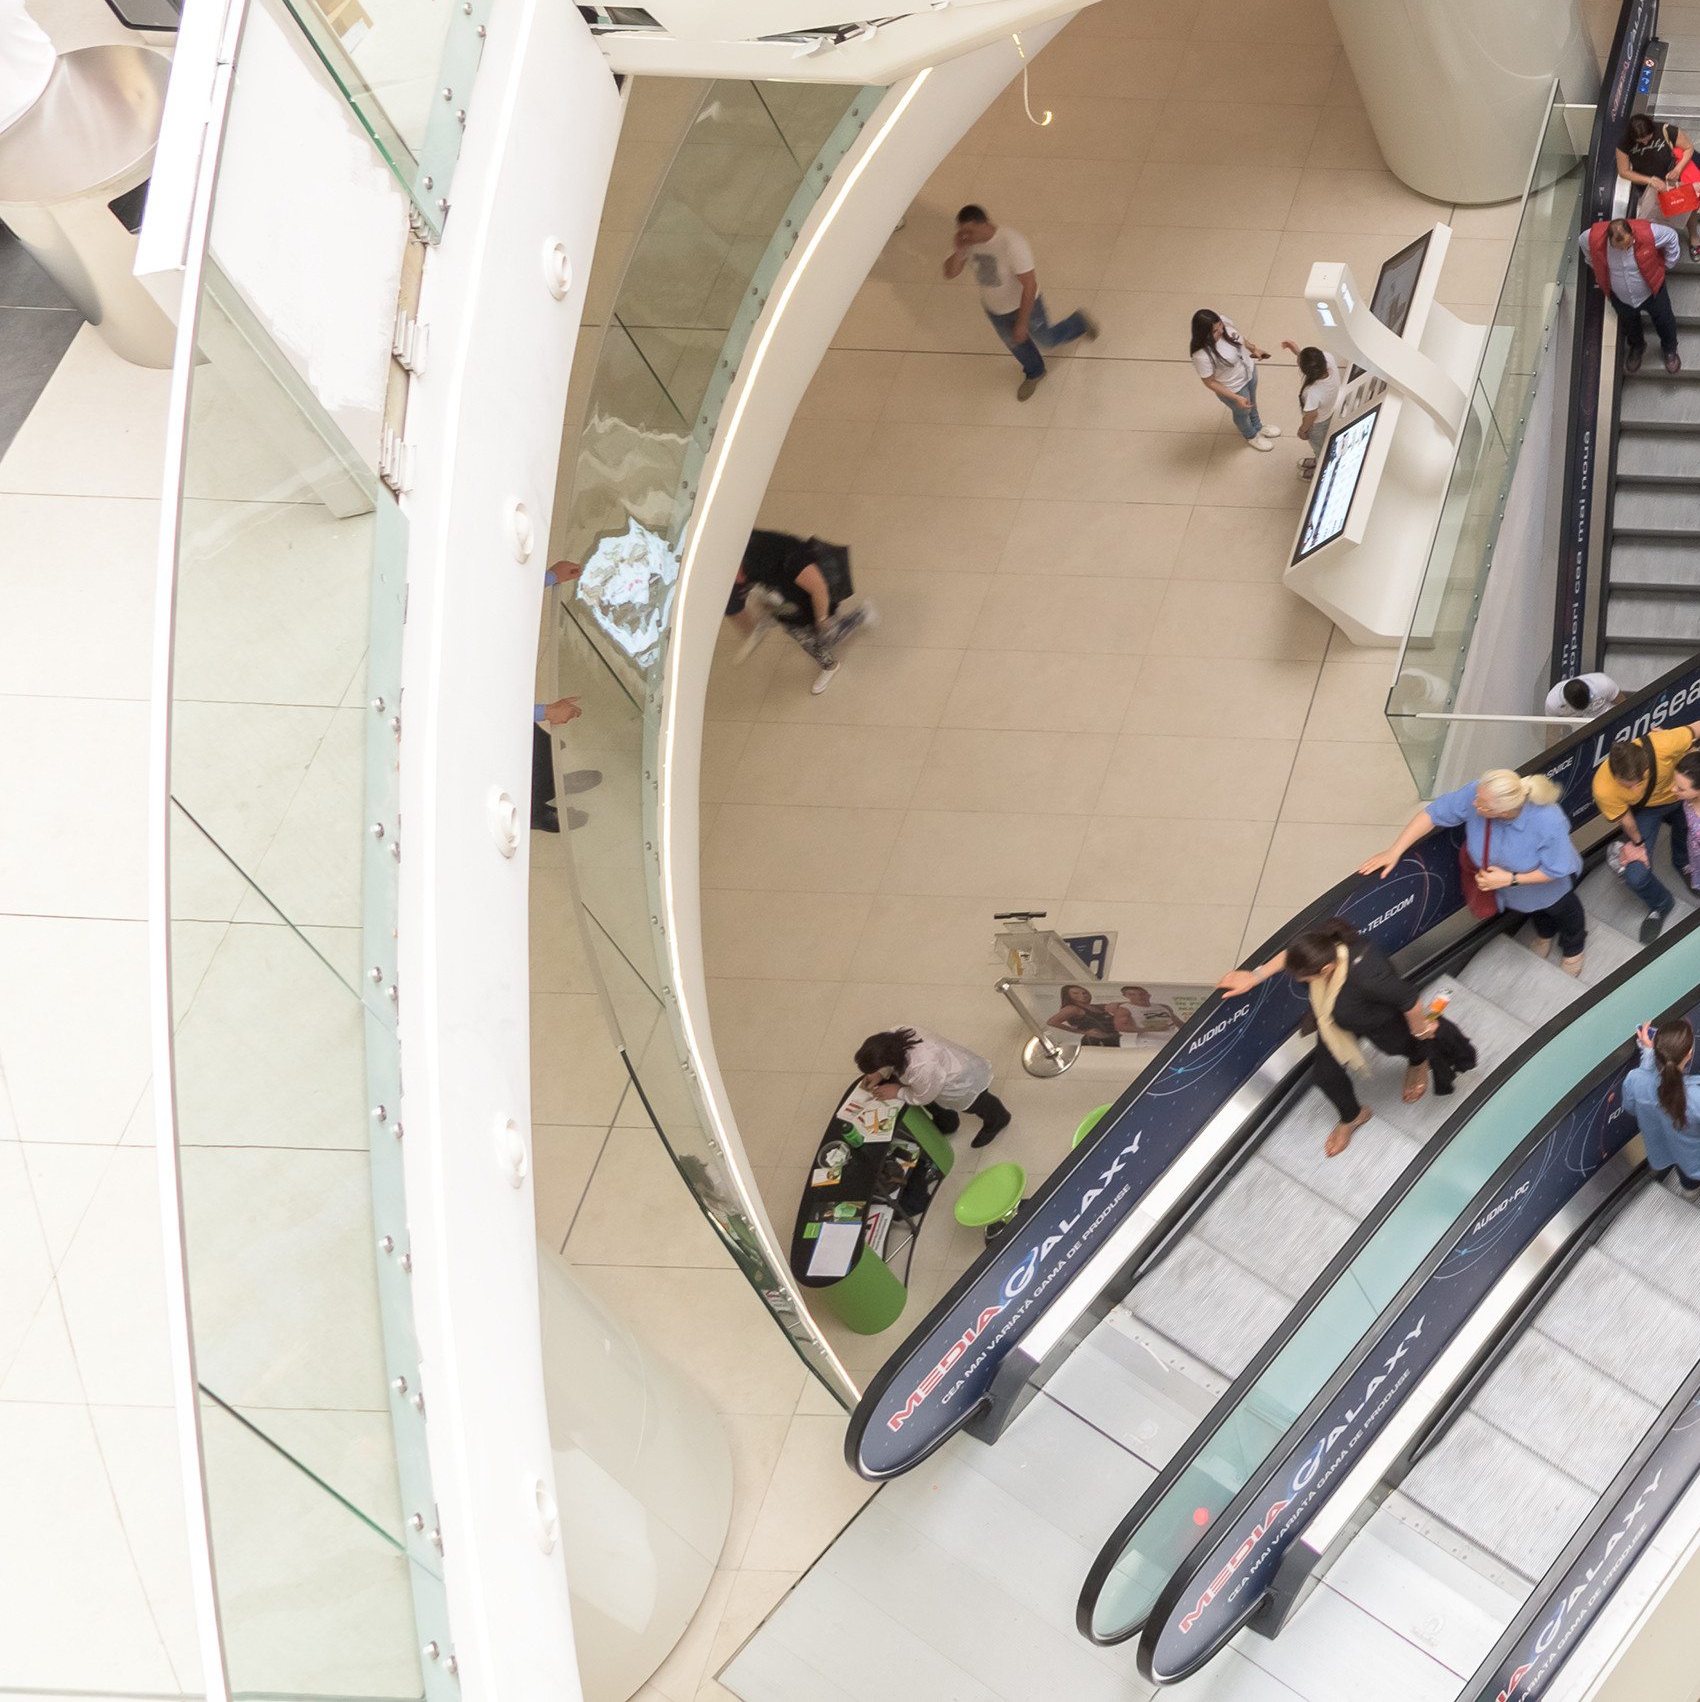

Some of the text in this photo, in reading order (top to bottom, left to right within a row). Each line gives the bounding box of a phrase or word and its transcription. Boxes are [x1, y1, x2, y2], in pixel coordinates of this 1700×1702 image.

[1577, 498, 1587, 544] mai
[1188, 1003, 1252, 1054] AUDIO+PC
[886, 1130, 1144, 1433] MEDIA GALAXY
[941, 1378, 966, 1405] CEA
[965, 1351, 988, 1378] MAI
[1066, 1240, 1083, 1260] DE
[1081, 1183, 1132, 1243] PRODUSE
[1472, 1180, 1531, 1235] AUDIO+PC
[1178, 1314, 1426, 1634] MEDIA GALAXY
[1227, 1575, 1251, 1603] CEA
[1250, 1546, 1272, 1575] MAI
[1347, 1430, 1364, 1449] DE
[1363, 1369, 1412, 1429] PRODUSE
[1534, 1467, 1664, 1656] GALAXY
[1588, 1588, 1603, 1608] DE
[1602, 1523, 1648, 1587] PRODUSE
